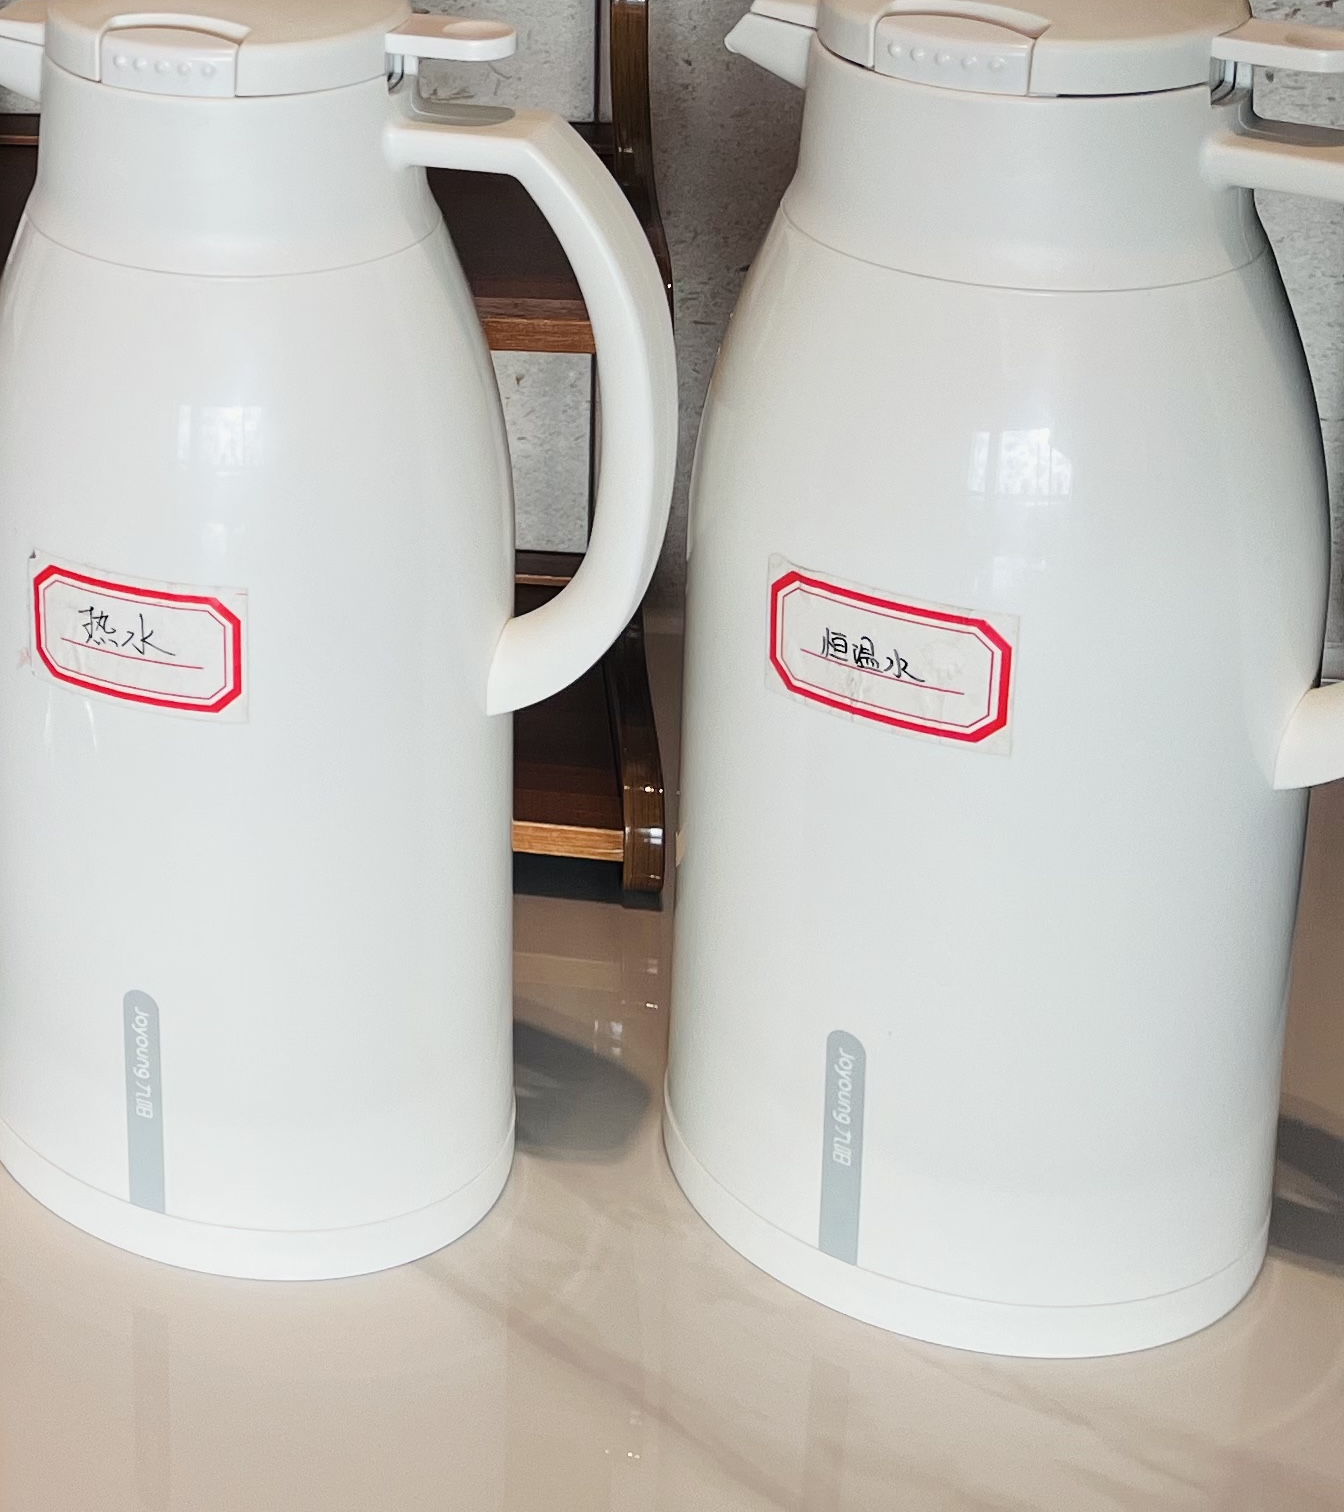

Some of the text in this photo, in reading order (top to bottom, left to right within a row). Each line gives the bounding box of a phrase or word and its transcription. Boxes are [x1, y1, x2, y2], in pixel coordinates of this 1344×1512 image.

[78, 606, 176, 656] 热水
[821, 627, 926, 683] 恒温水
[131, 1005, 151, 1080] Joyoung
[831, 1046, 856, 1126] Joyoung
